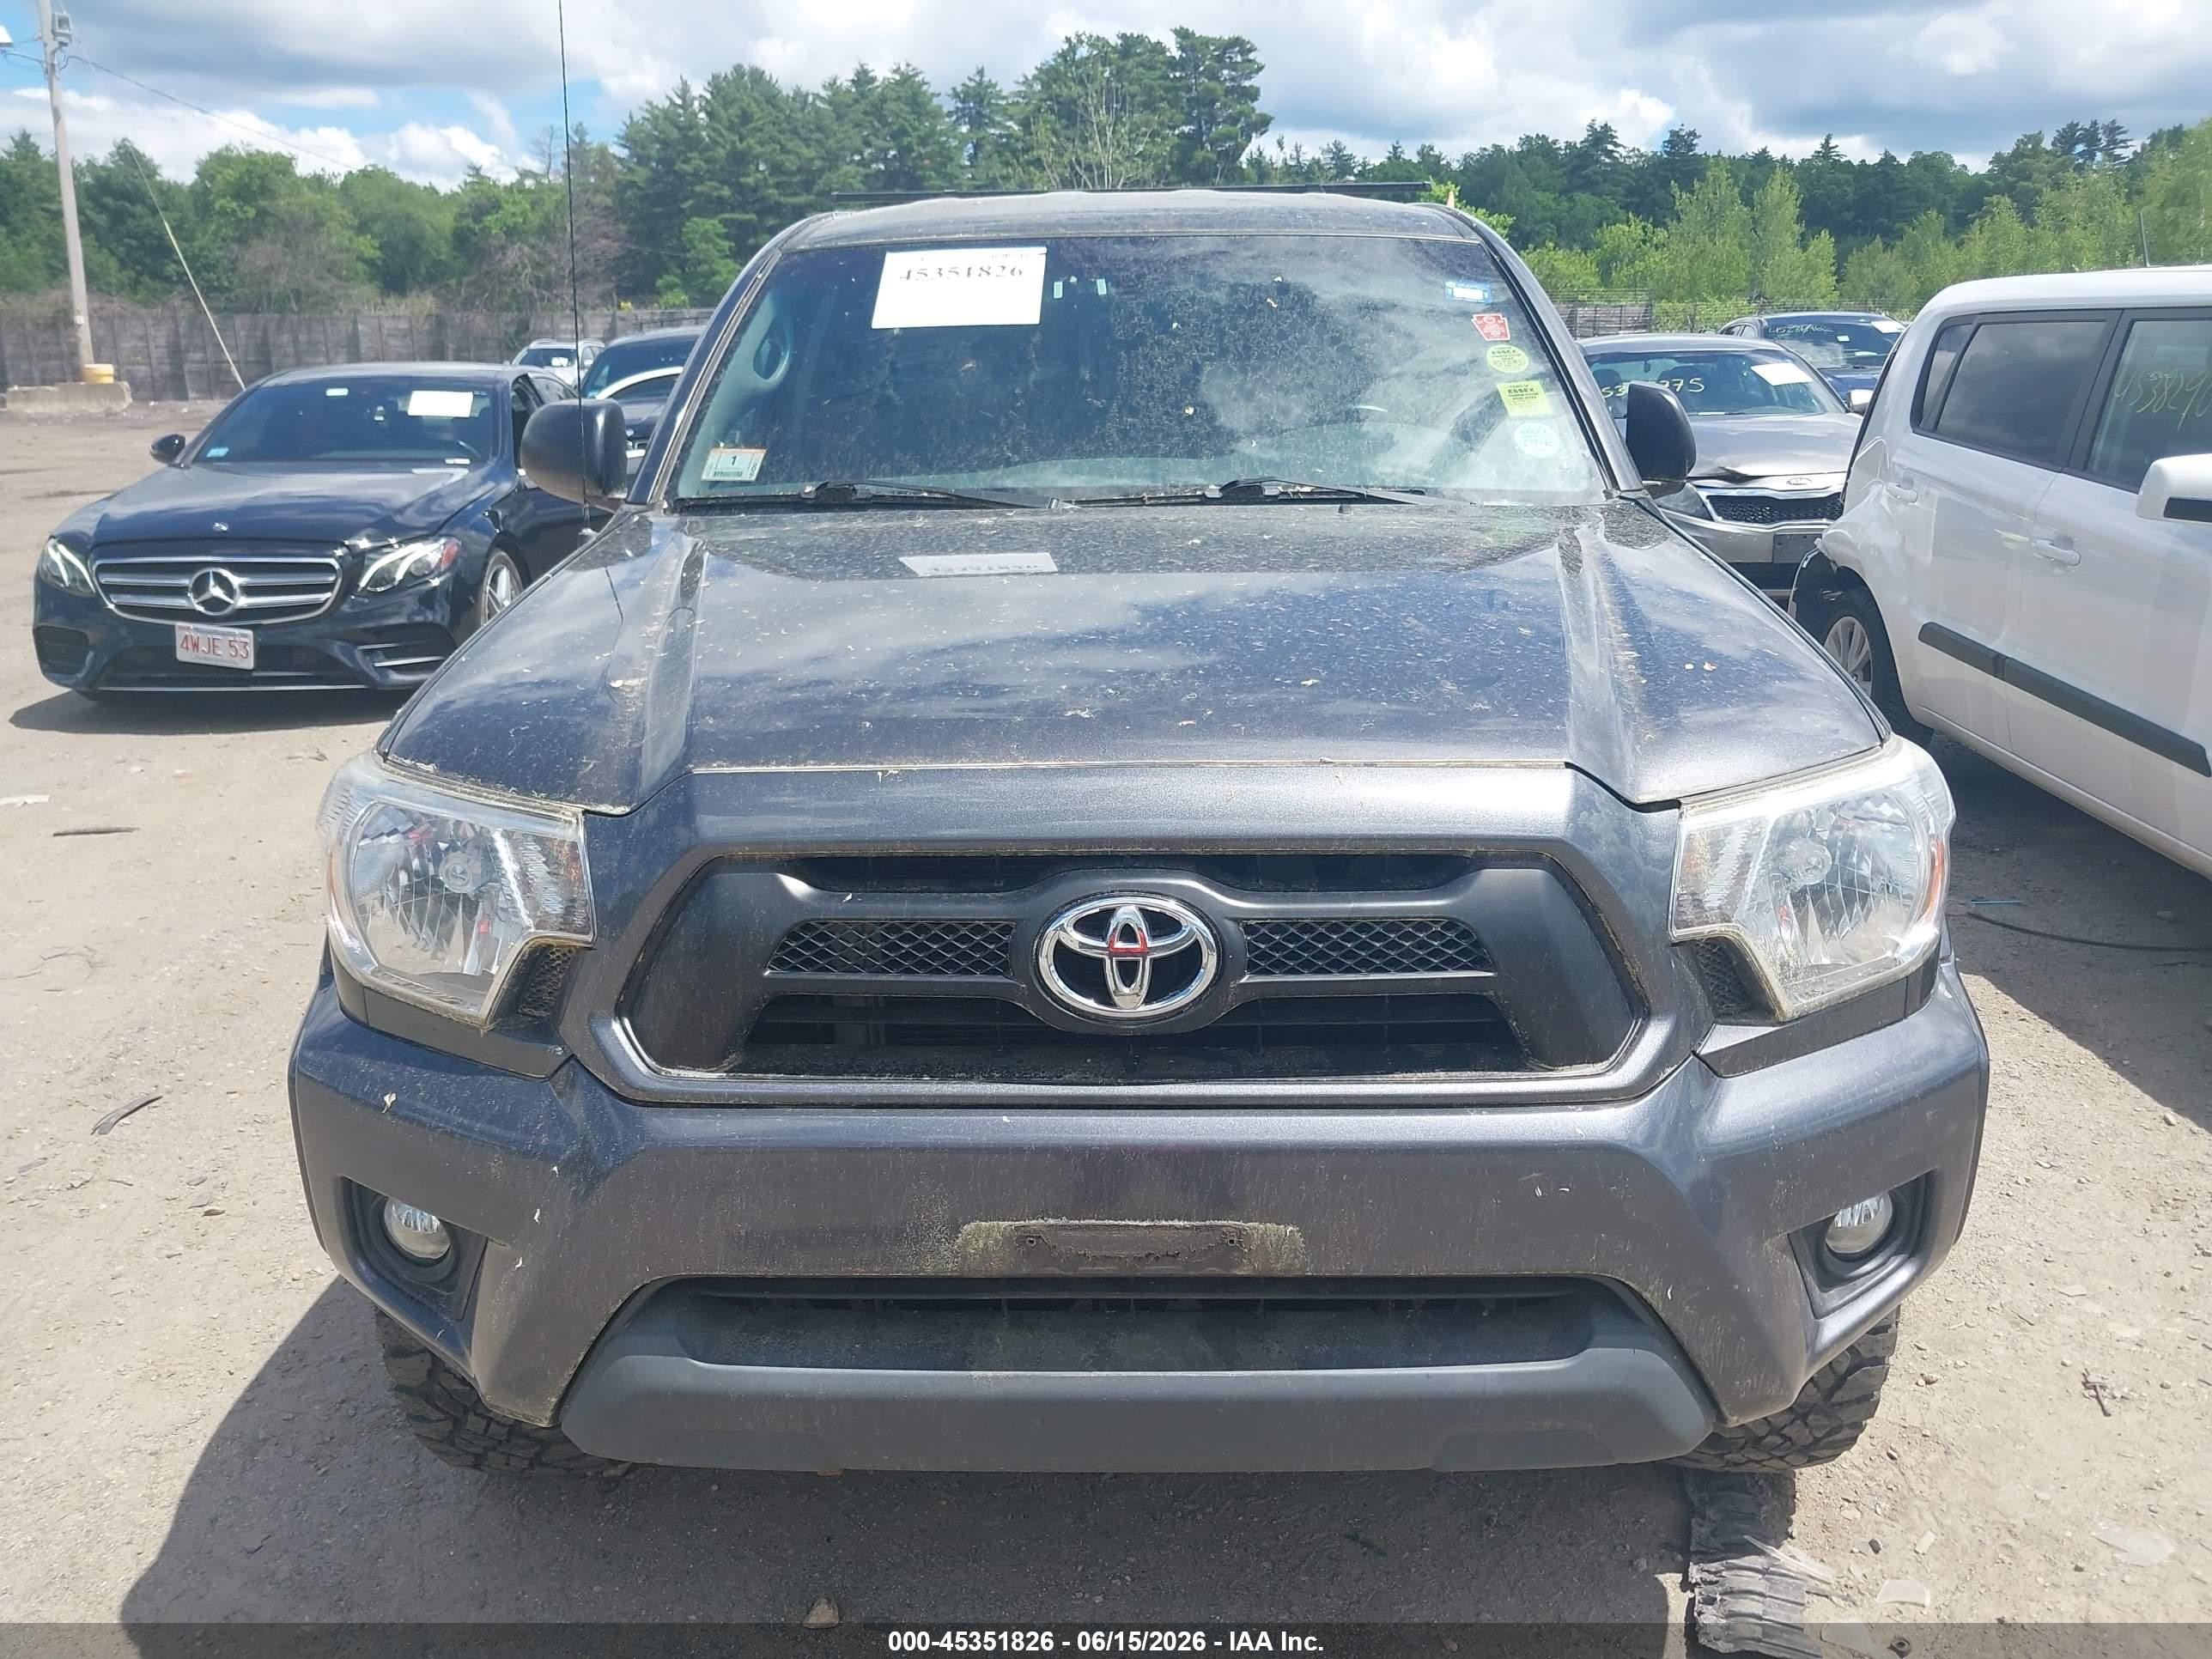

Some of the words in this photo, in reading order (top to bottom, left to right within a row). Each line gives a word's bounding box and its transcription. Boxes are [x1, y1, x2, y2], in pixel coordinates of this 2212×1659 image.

[899, 264, 1024, 282] 45351826
[730, 455, 738, 465] 1
[179, 634, 222, 657] 4WJE
[228, 638, 250, 660] 53
